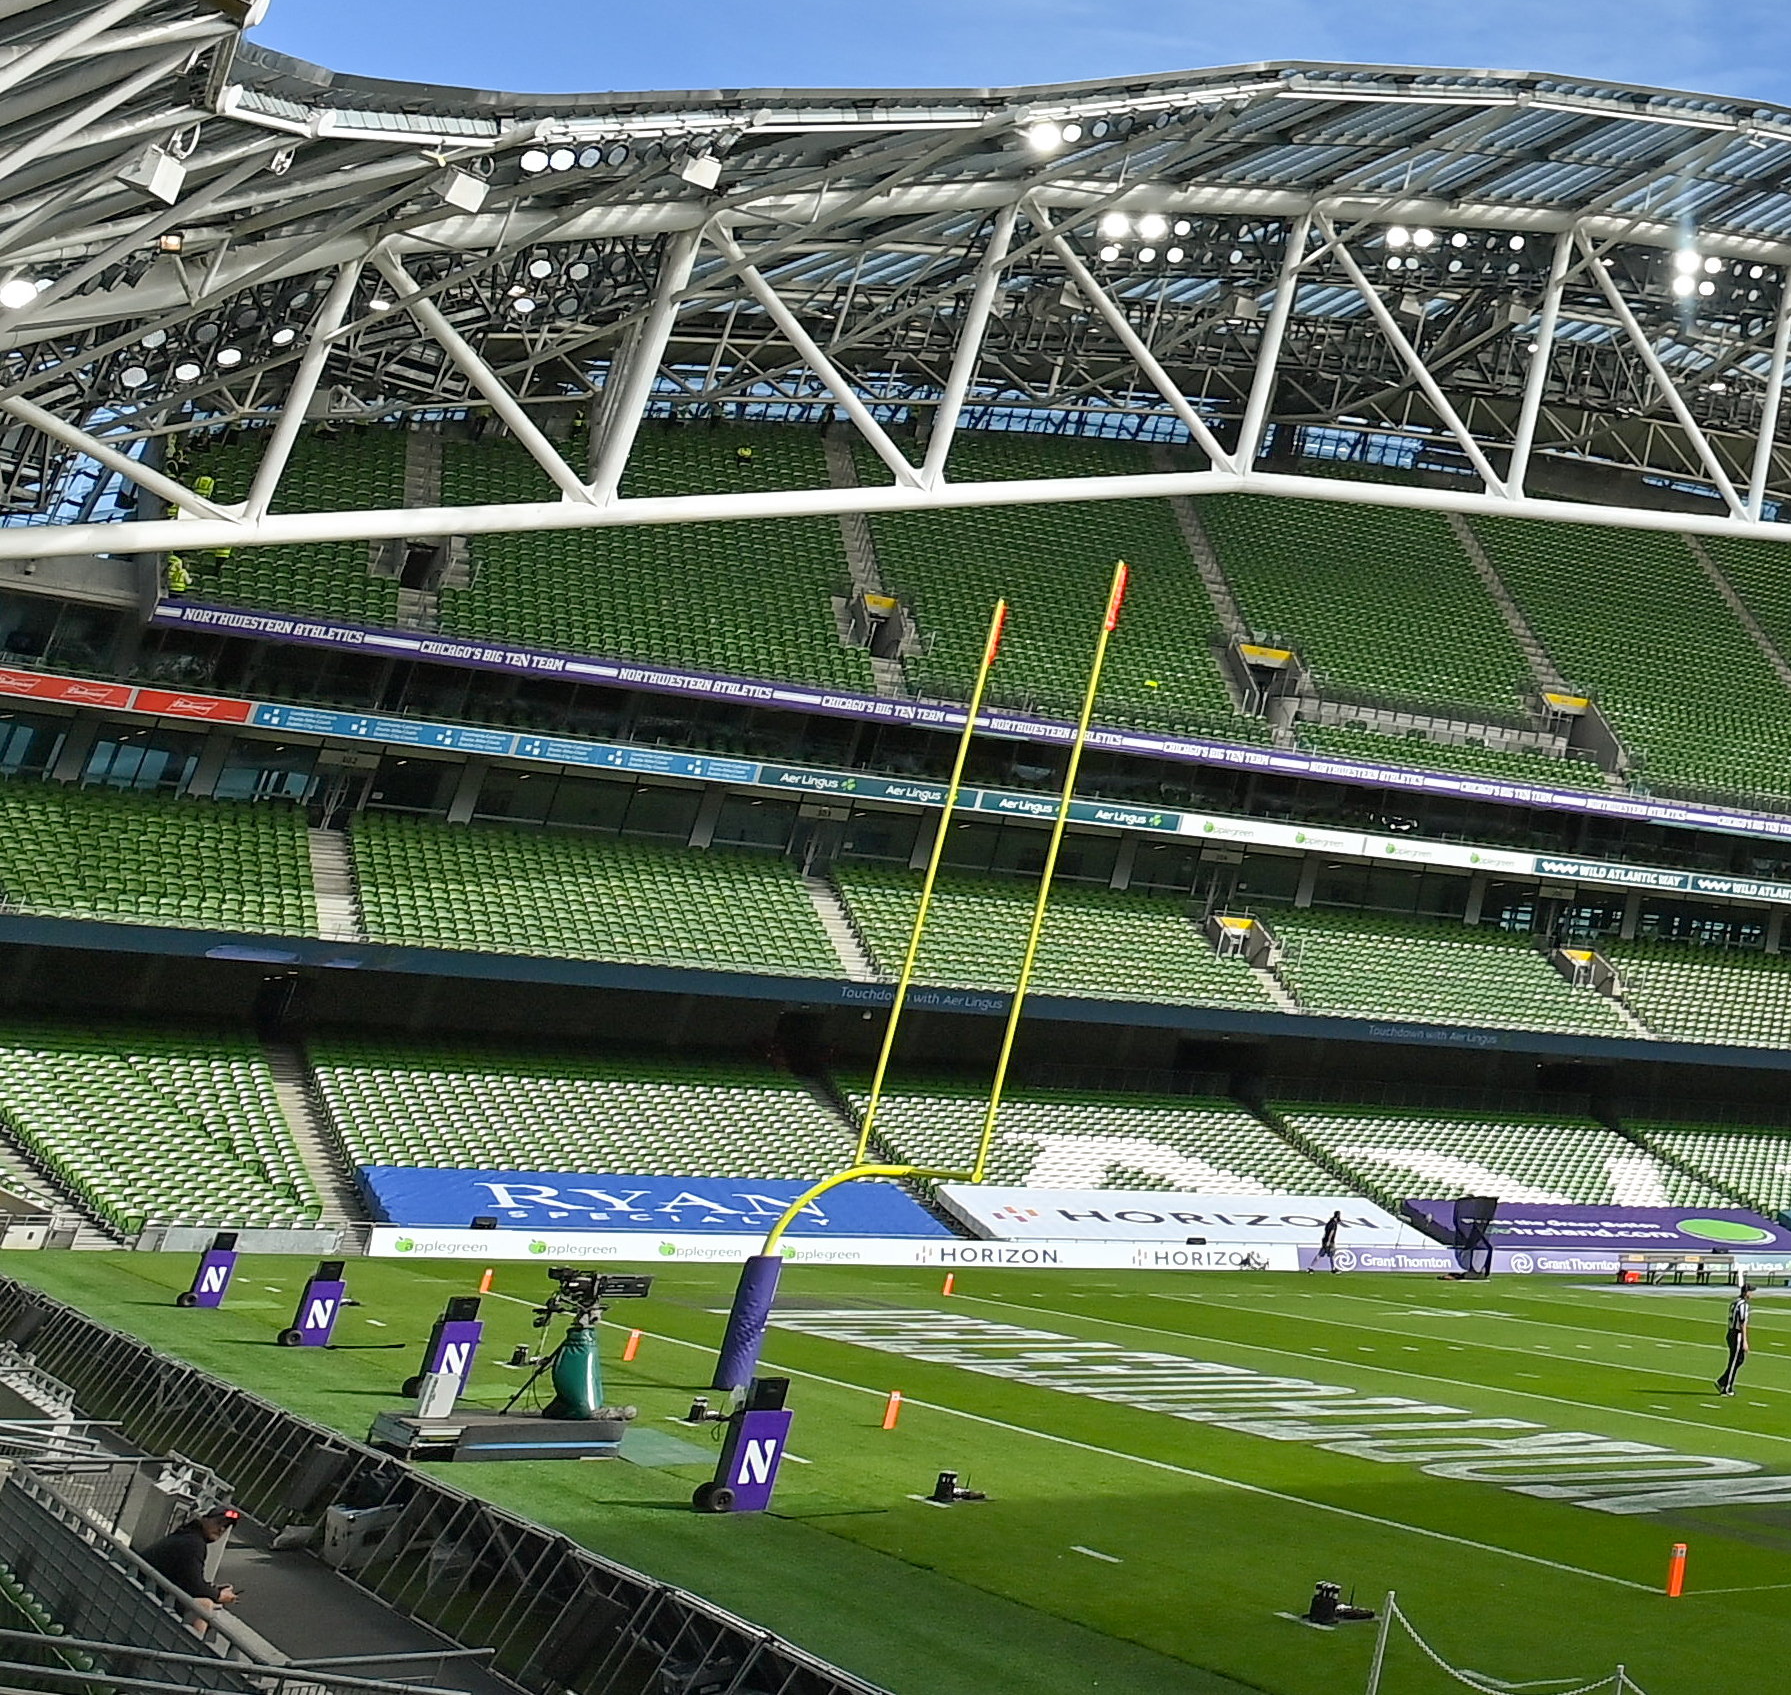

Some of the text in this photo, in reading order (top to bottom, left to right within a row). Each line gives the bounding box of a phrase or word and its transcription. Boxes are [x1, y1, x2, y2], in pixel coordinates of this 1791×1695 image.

[182, 608, 364, 643] NORTHWESTERN ATHLETICS
[420, 641, 565, 671] CHICAGO'S BIG TEN TEAM
[618, 668, 773, 700] NORTHWESTERN ATHLETICS
[822, 696, 945, 722] CHICAGO'S BIG TEN TEAM
[989, 718, 1122, 745] NORTHWESTERN AHLETICS
[780, 772, 839, 789] Aer Lingus
[885, 784, 941, 801] Aer Lingus
[1000, 798, 1053, 814] Aer Lingus
[1095, 810, 1146, 825] Aer Lingus
[1579, 865, 1683, 887] WILD ATLANTIC WAY
[1733, 881, 1757, 894] WILD
[912, 992, 940, 1004] with
[943, 994, 964, 1006] Aer
[965, 996, 1003, 1011] Lingus
[1368, 1026, 1497, 1046] Touchdown with Aer Lingus
[473, 1182, 827, 1217] RYAN
[1055, 1209, 1380, 1228] HORIZON
[1511, 1227, 1679, 1239] Ireland.com
[940, 1248, 1058, 1265] HORIZON
[1155, 1251, 1262, 1267] HORIZO
[201, 1266, 227, 1292] N
[306, 1299, 334, 1328] N
[440, 1343, 471, 1373] N
[737, 1439, 777, 1484] N
